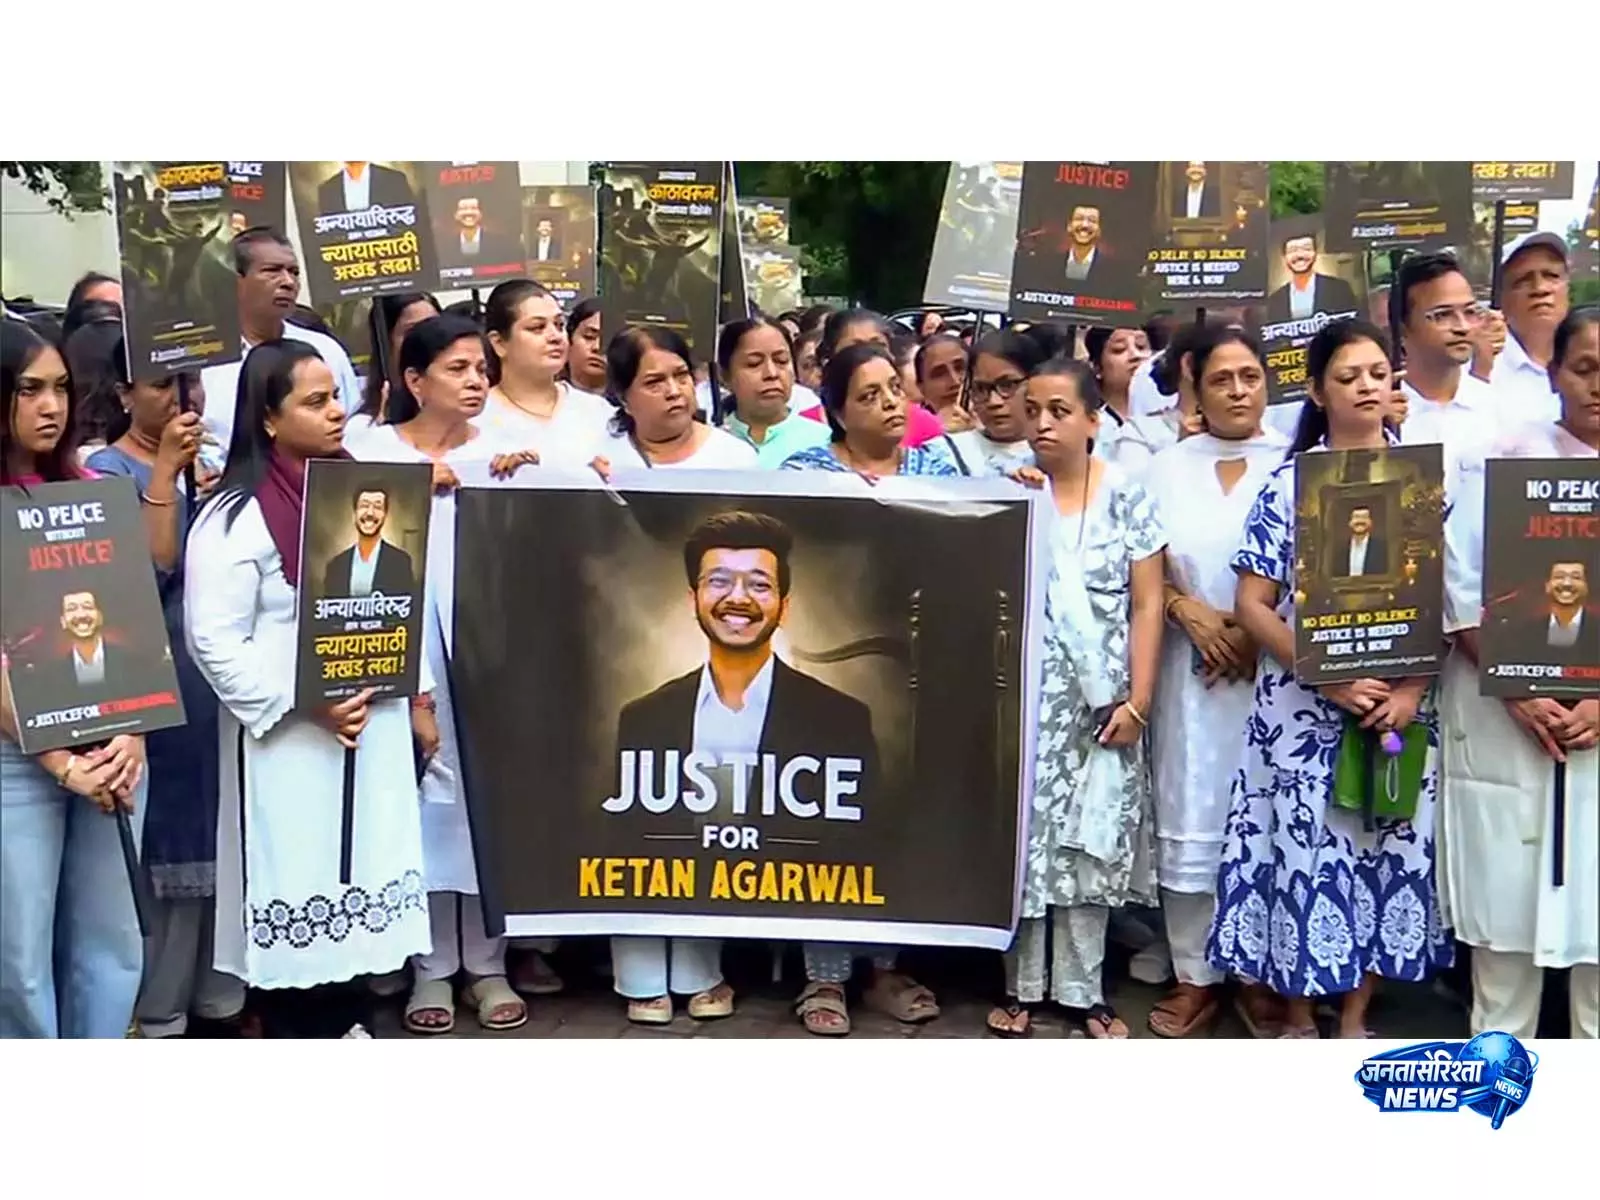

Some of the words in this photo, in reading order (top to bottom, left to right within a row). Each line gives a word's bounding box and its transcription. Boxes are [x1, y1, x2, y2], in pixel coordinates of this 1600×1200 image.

[1526, 480, 1552, 499] NO
[1557, 480, 1600, 499] PEAC
[17, 508, 44, 530] NO
[48, 502, 106, 527] PEACE
[1524, 515, 1600, 538] JUSTIC
[315, 626, 408, 656] न्यायासाठी
[601, 749, 863, 821] JUSTICE
[702, 825, 760, 851] FOR
[578, 857, 696, 899] KETAN
[709, 859, 886, 906] AGARWAL
